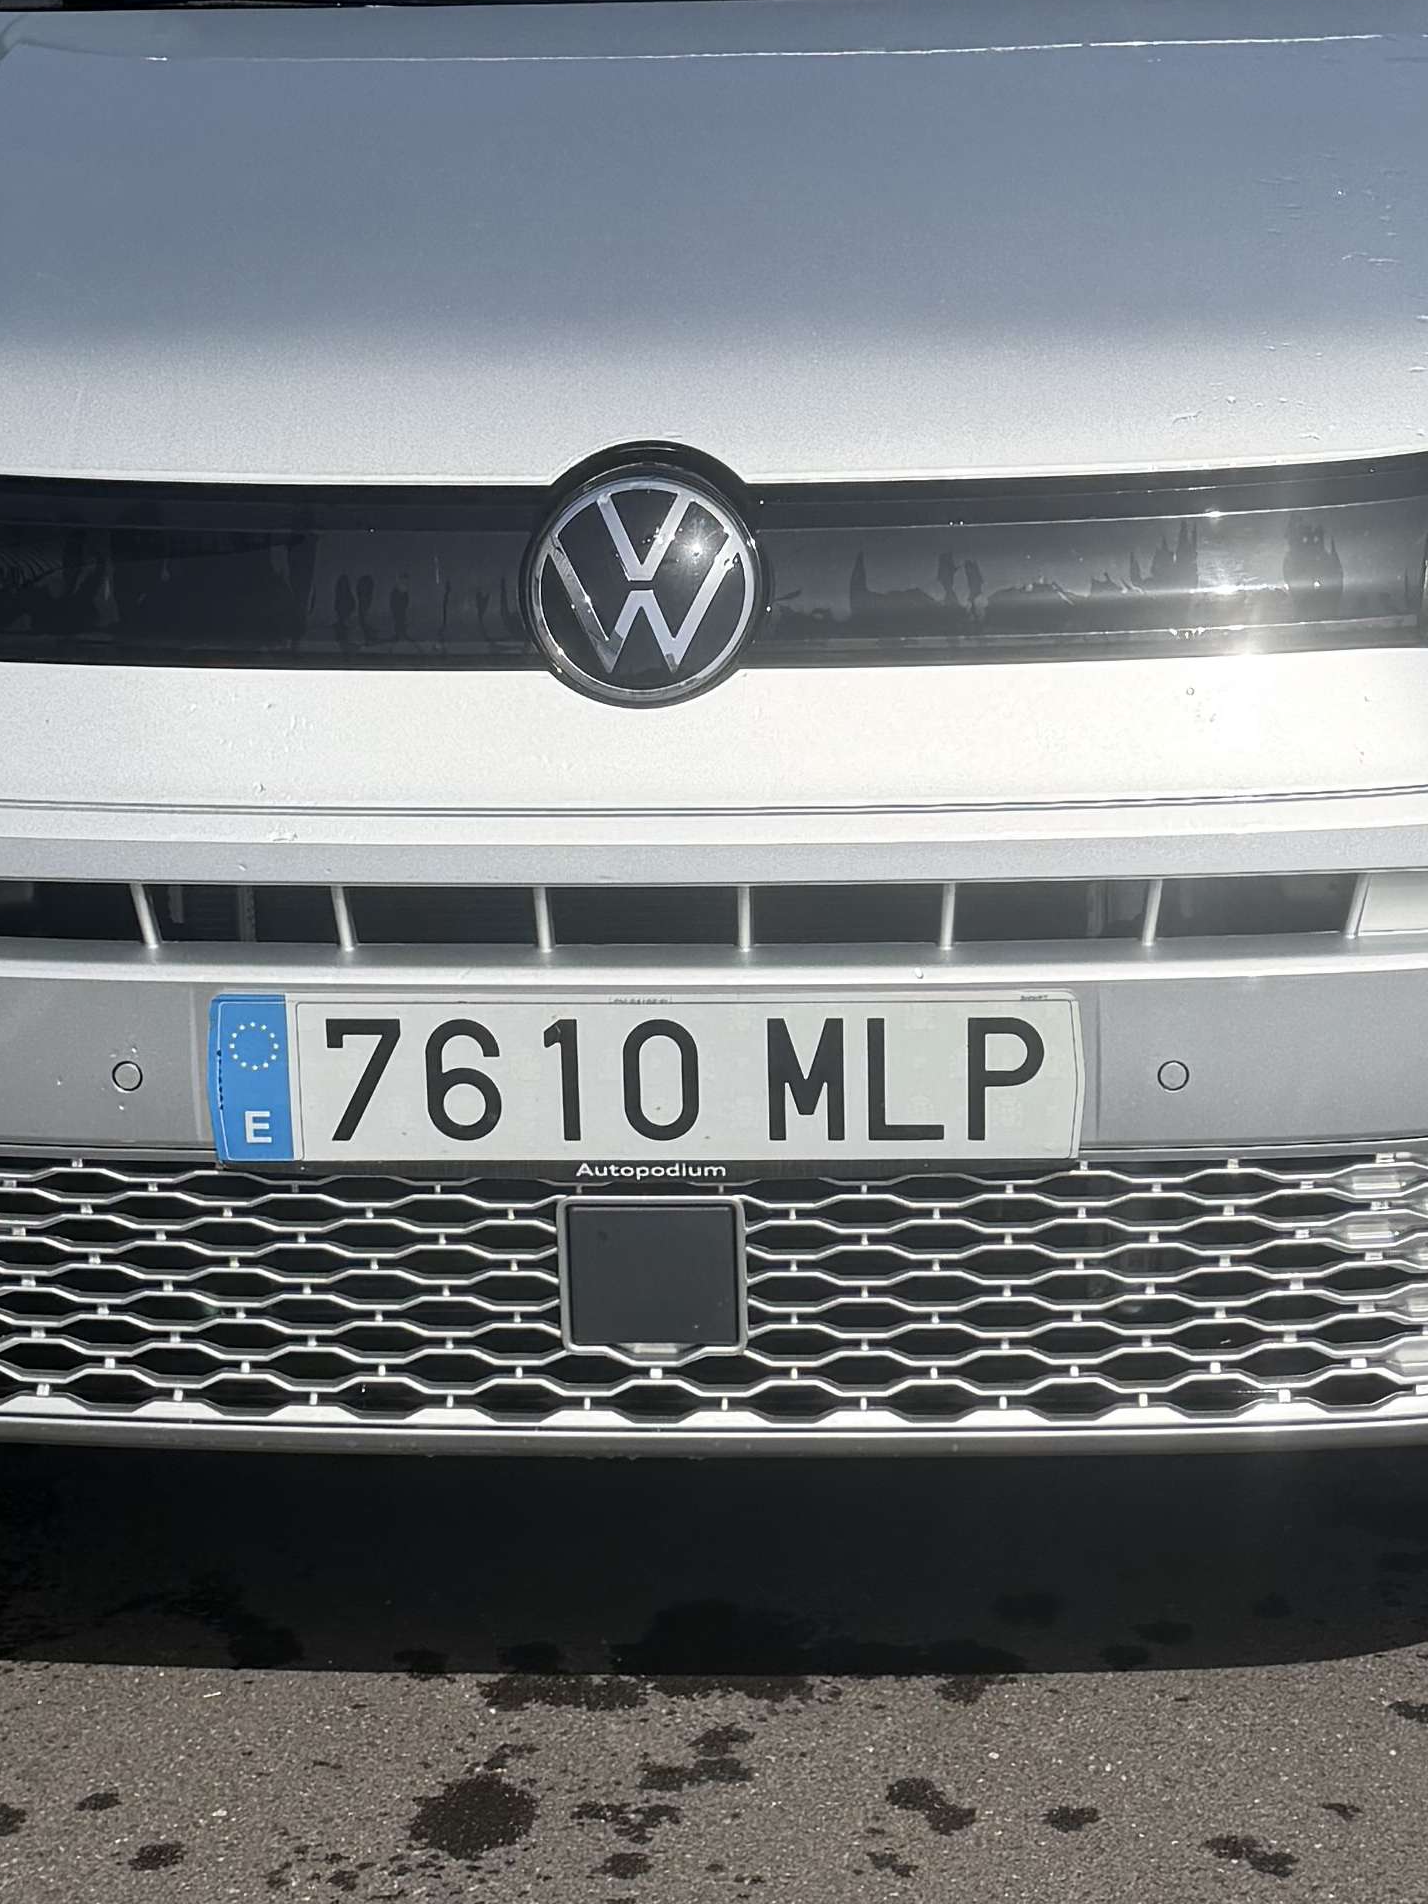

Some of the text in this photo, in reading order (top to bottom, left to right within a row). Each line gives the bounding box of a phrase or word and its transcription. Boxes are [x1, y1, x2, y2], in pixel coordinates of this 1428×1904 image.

[324, 1016, 1046, 1142] 7610 MLP
[244, 1110, 272, 1145] E
[575, 1160, 728, 1182] Autopodium
